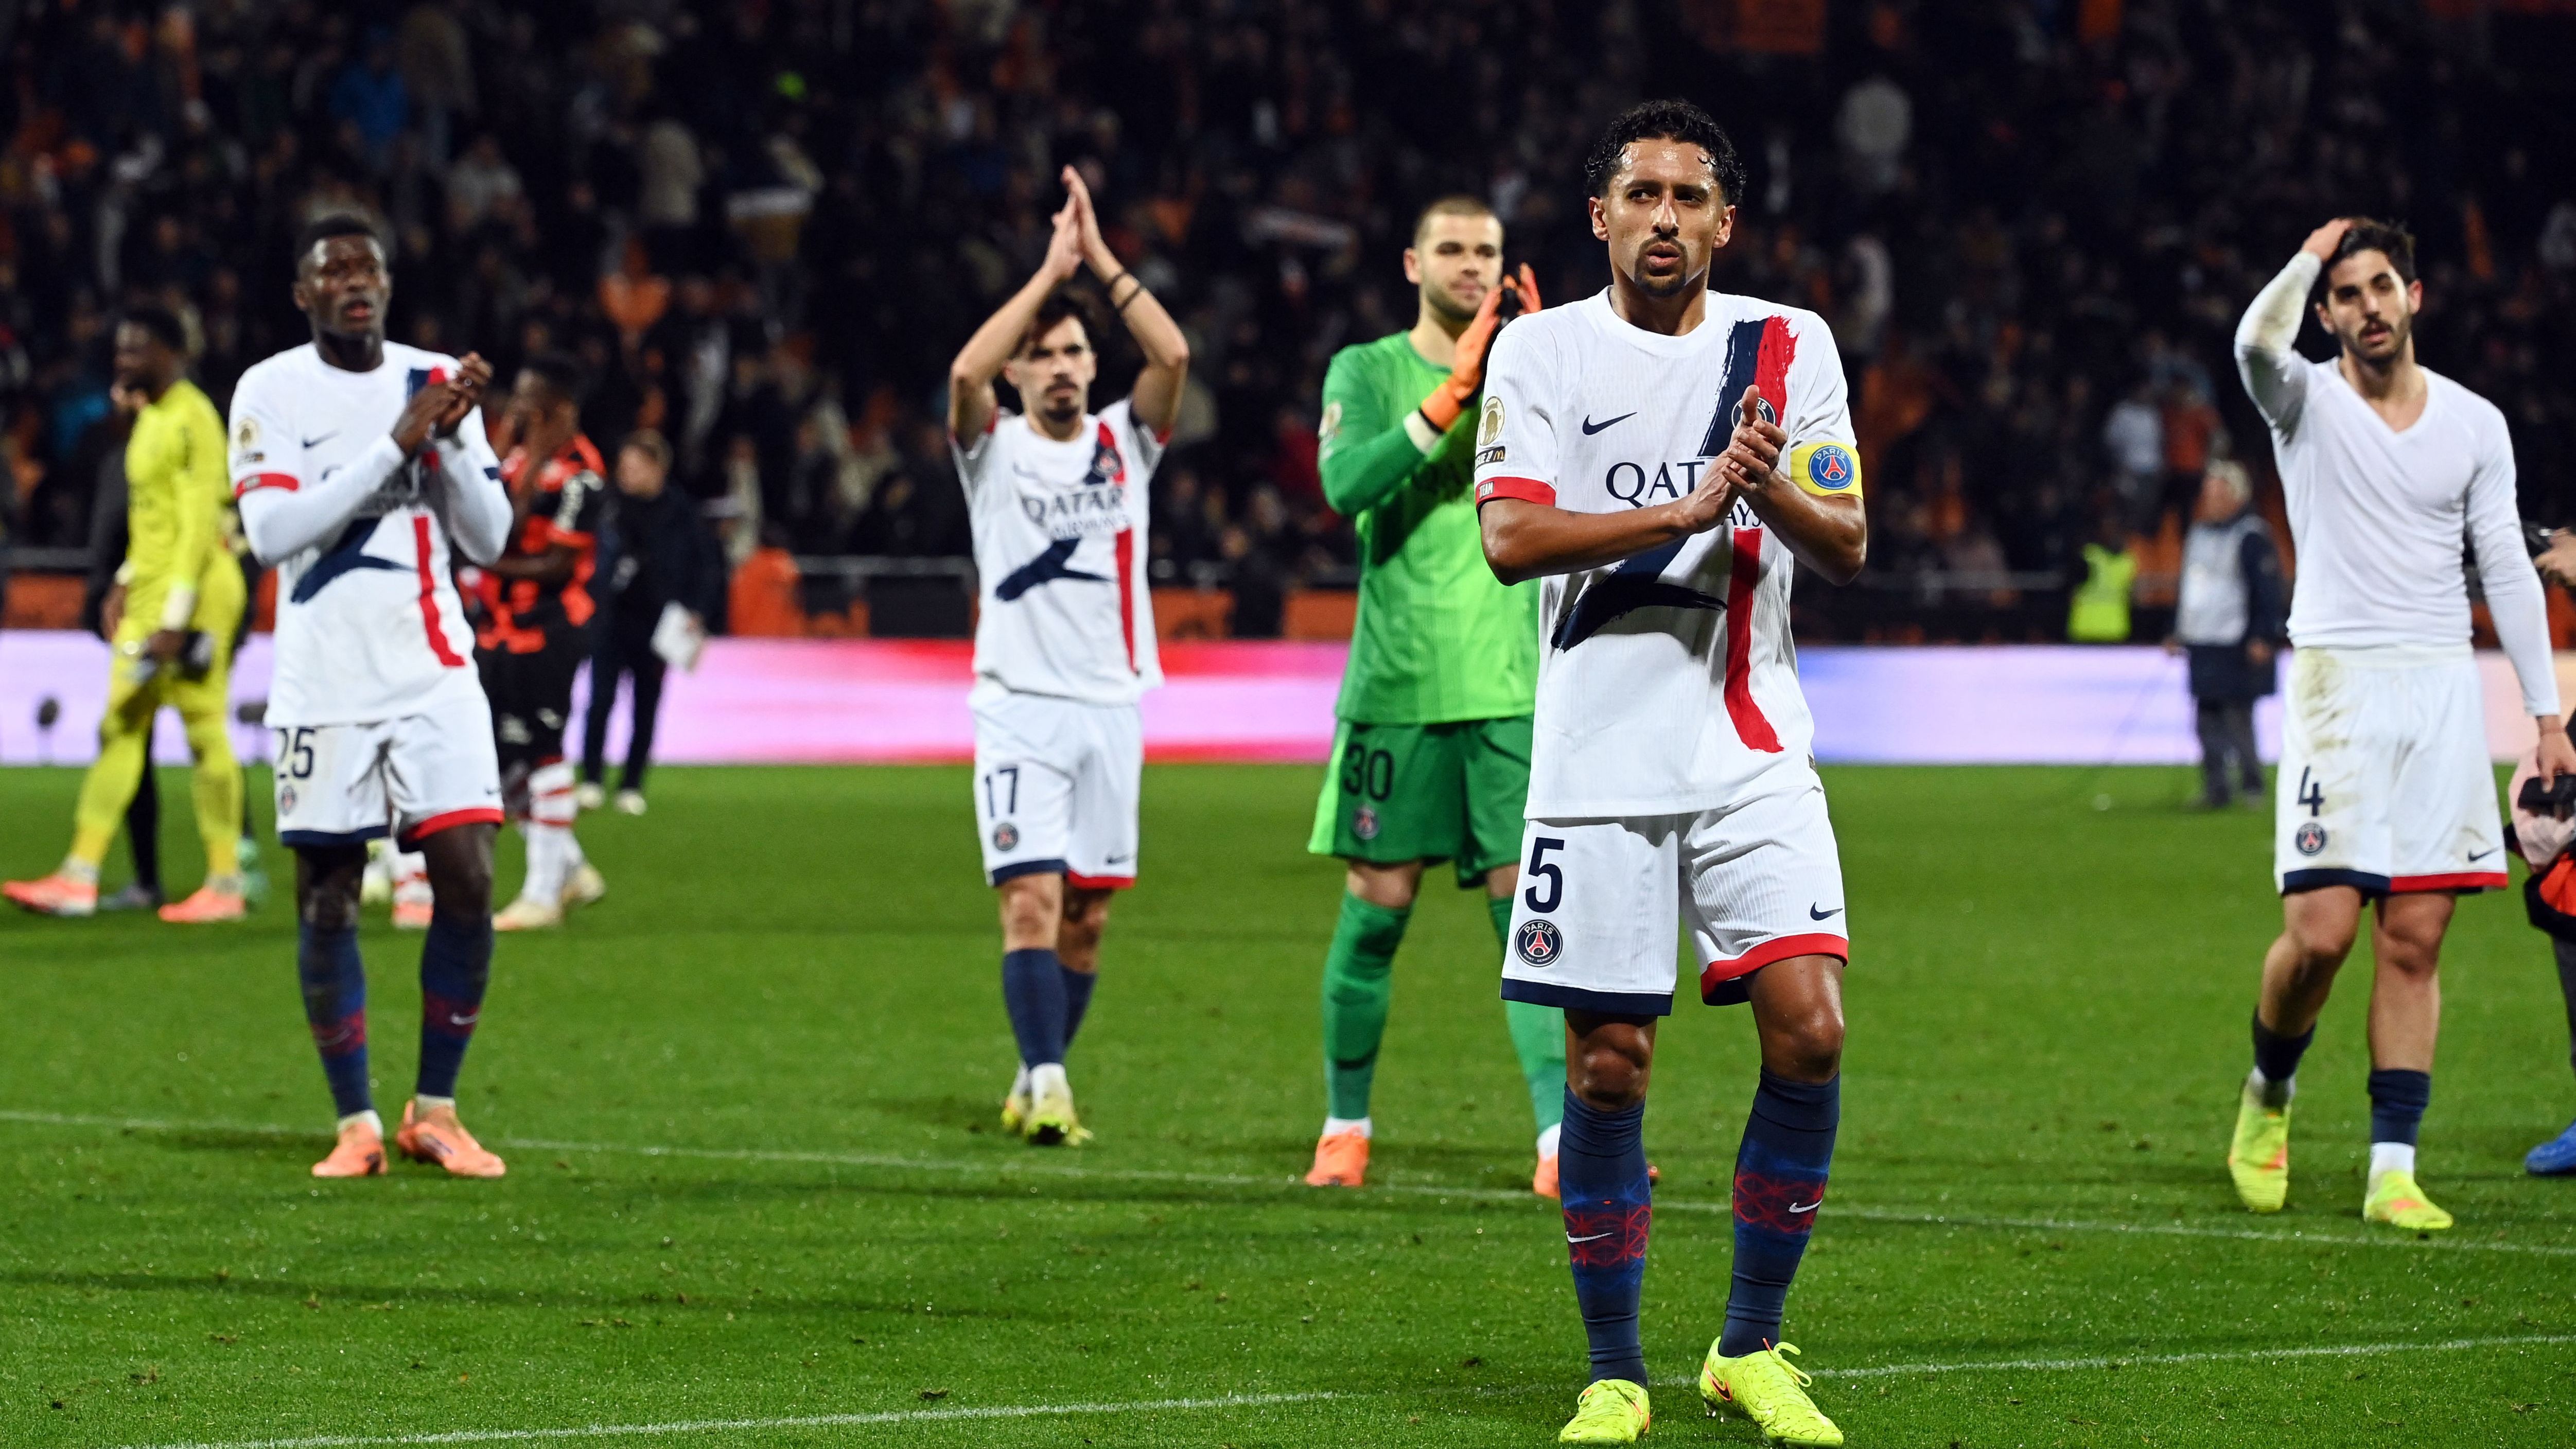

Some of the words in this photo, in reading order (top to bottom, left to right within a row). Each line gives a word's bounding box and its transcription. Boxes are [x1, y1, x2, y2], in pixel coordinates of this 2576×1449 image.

[1815, 448, 1846, 460] PARIS
[1021, 487, 1123, 528] QATAR
[1606, 461, 1705, 508] QAT
[278, 727, 315, 778] 25
[1344, 743, 1394, 801] 30
[985, 767, 1018, 817] 17
[2298, 765, 2324, 816] 4
[1525, 836, 1565, 913] 5
[1524, 923, 1554, 934] PARIS
